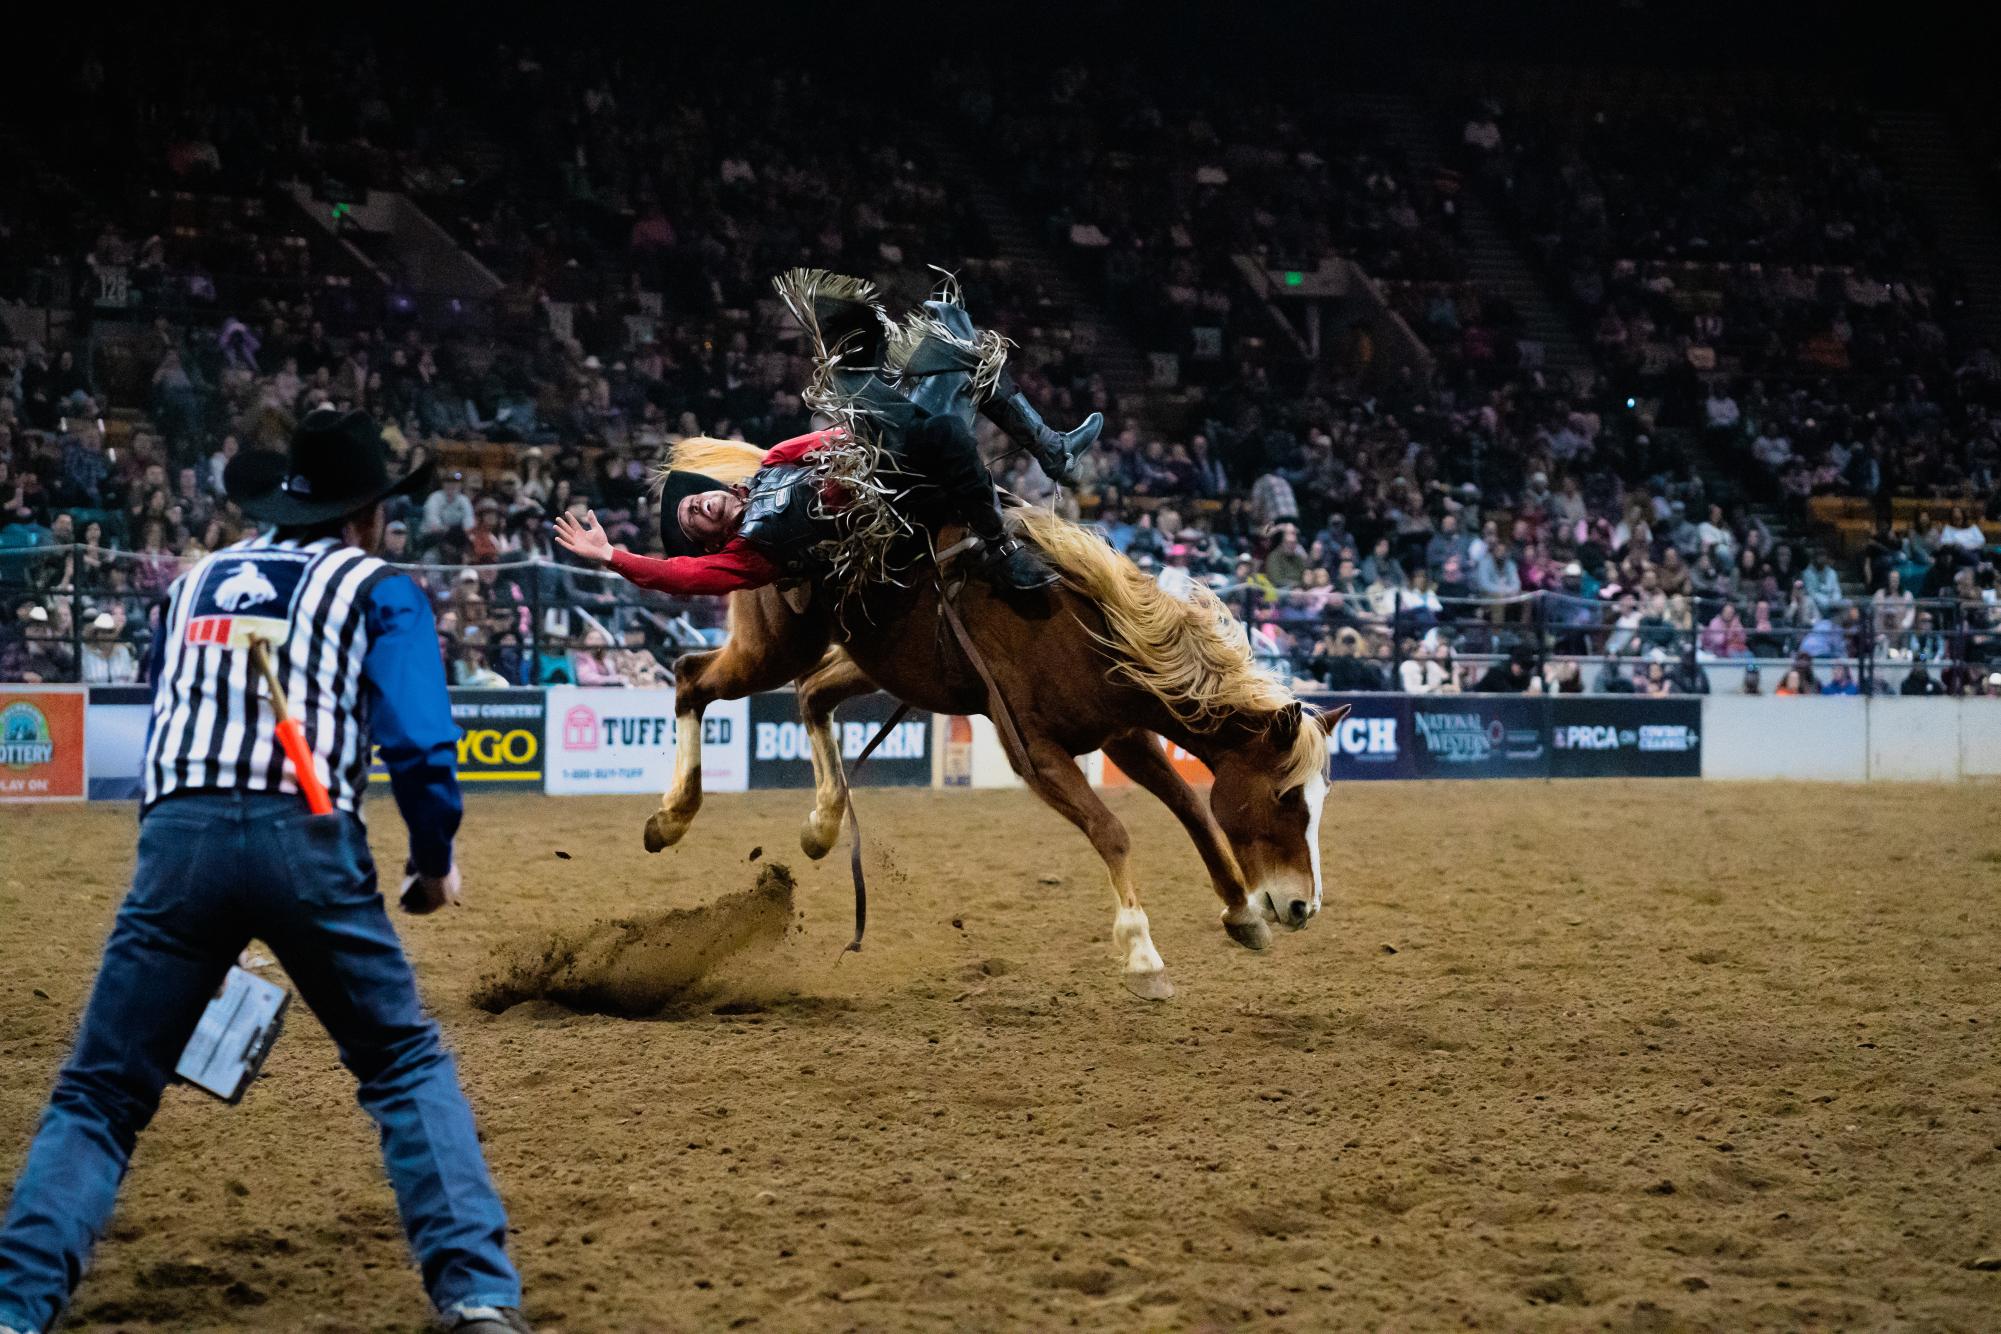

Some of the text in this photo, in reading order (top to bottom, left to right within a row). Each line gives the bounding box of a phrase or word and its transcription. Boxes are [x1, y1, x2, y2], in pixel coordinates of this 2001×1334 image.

[602, 717, 732, 746] TUFF ED
[1567, 725, 1619, 749] PRCA
